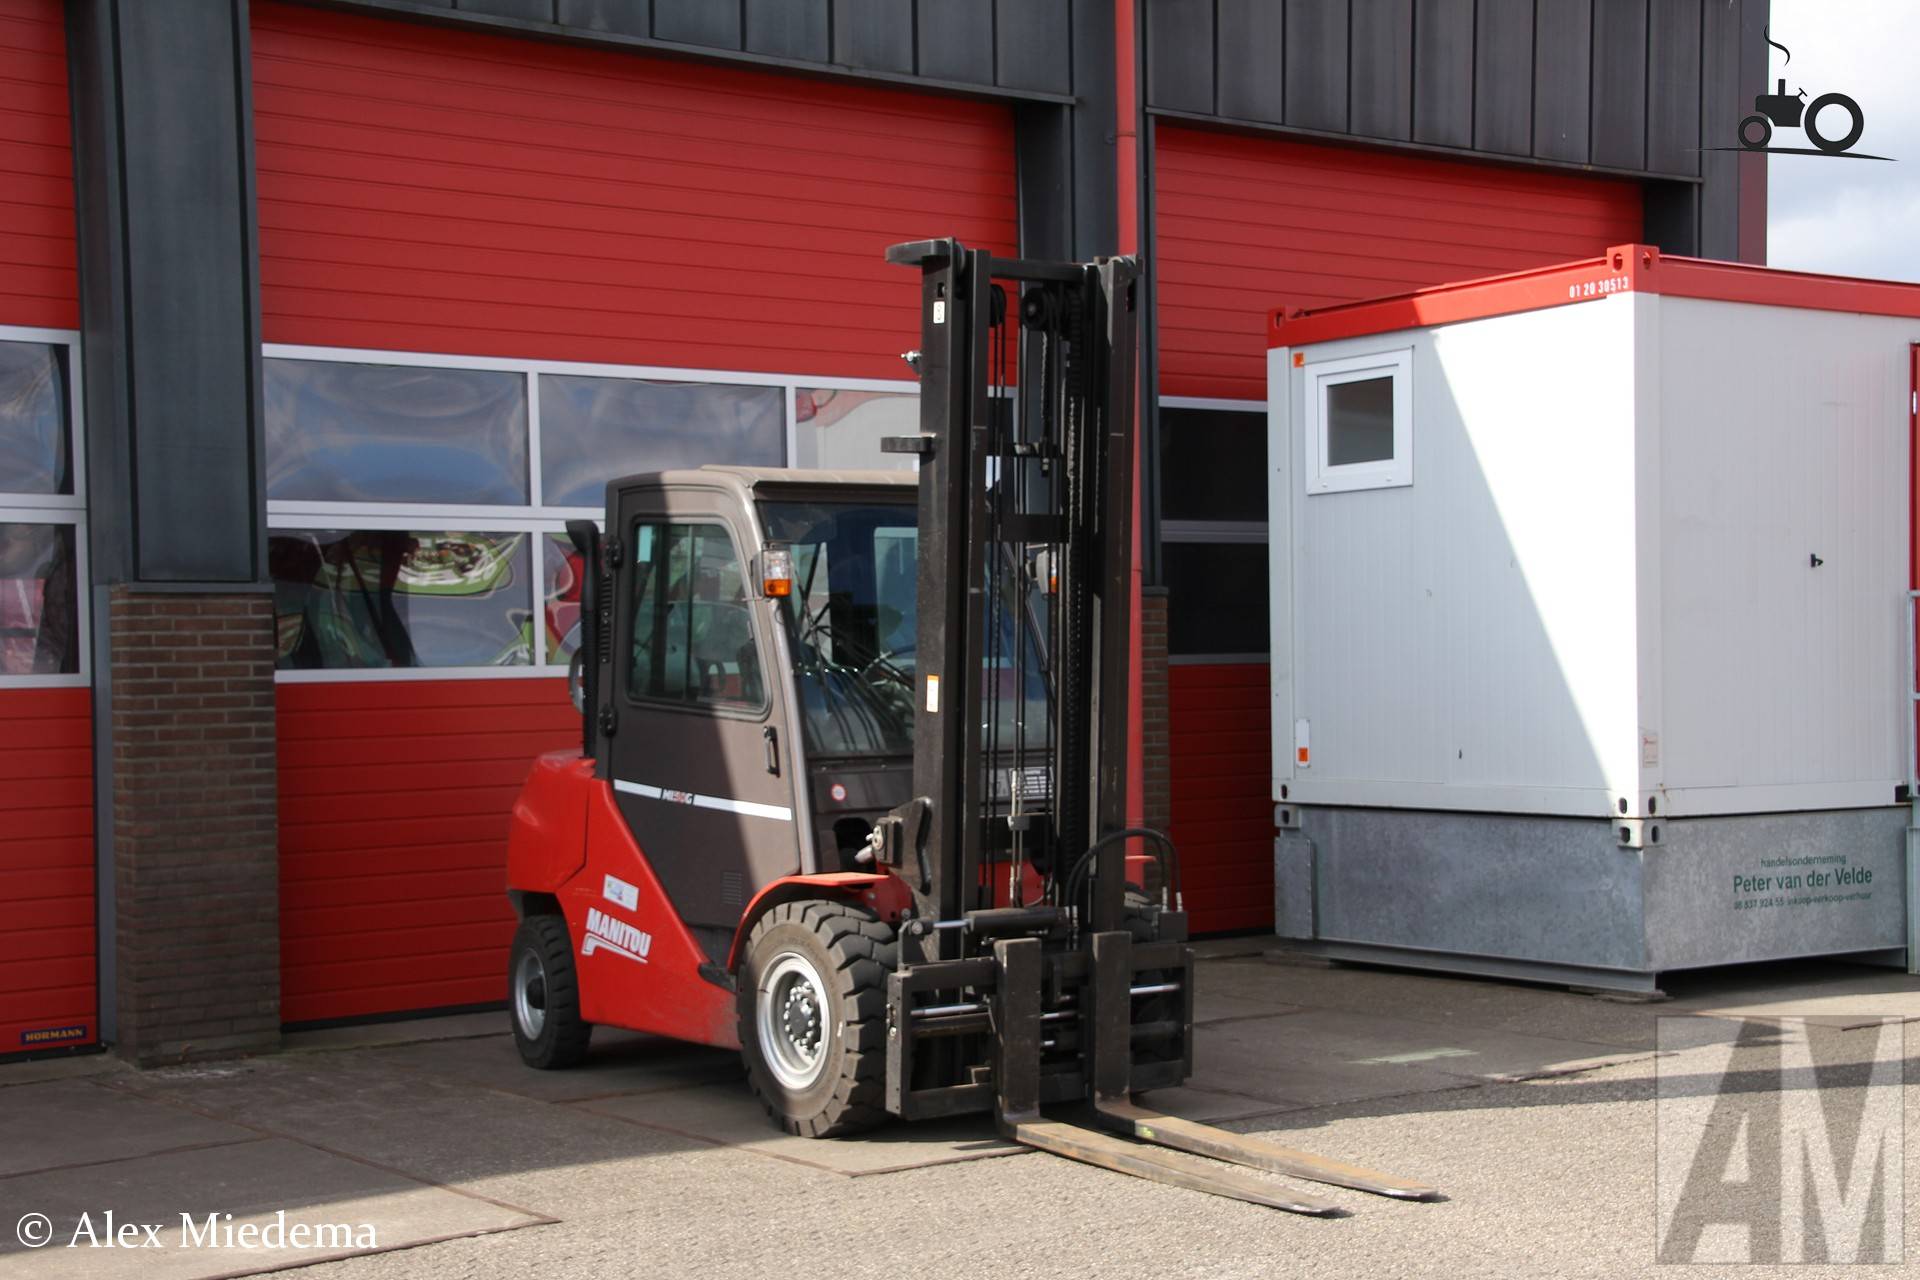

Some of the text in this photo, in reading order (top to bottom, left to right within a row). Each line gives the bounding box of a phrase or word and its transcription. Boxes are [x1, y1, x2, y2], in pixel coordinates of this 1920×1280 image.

[1569, 285, 1580, 298] 01
[1583, 282, 1595, 296] 20
[1733, 867, 1872, 893] Peter van der Velde
[585, 906, 652, 958] MANITOU
